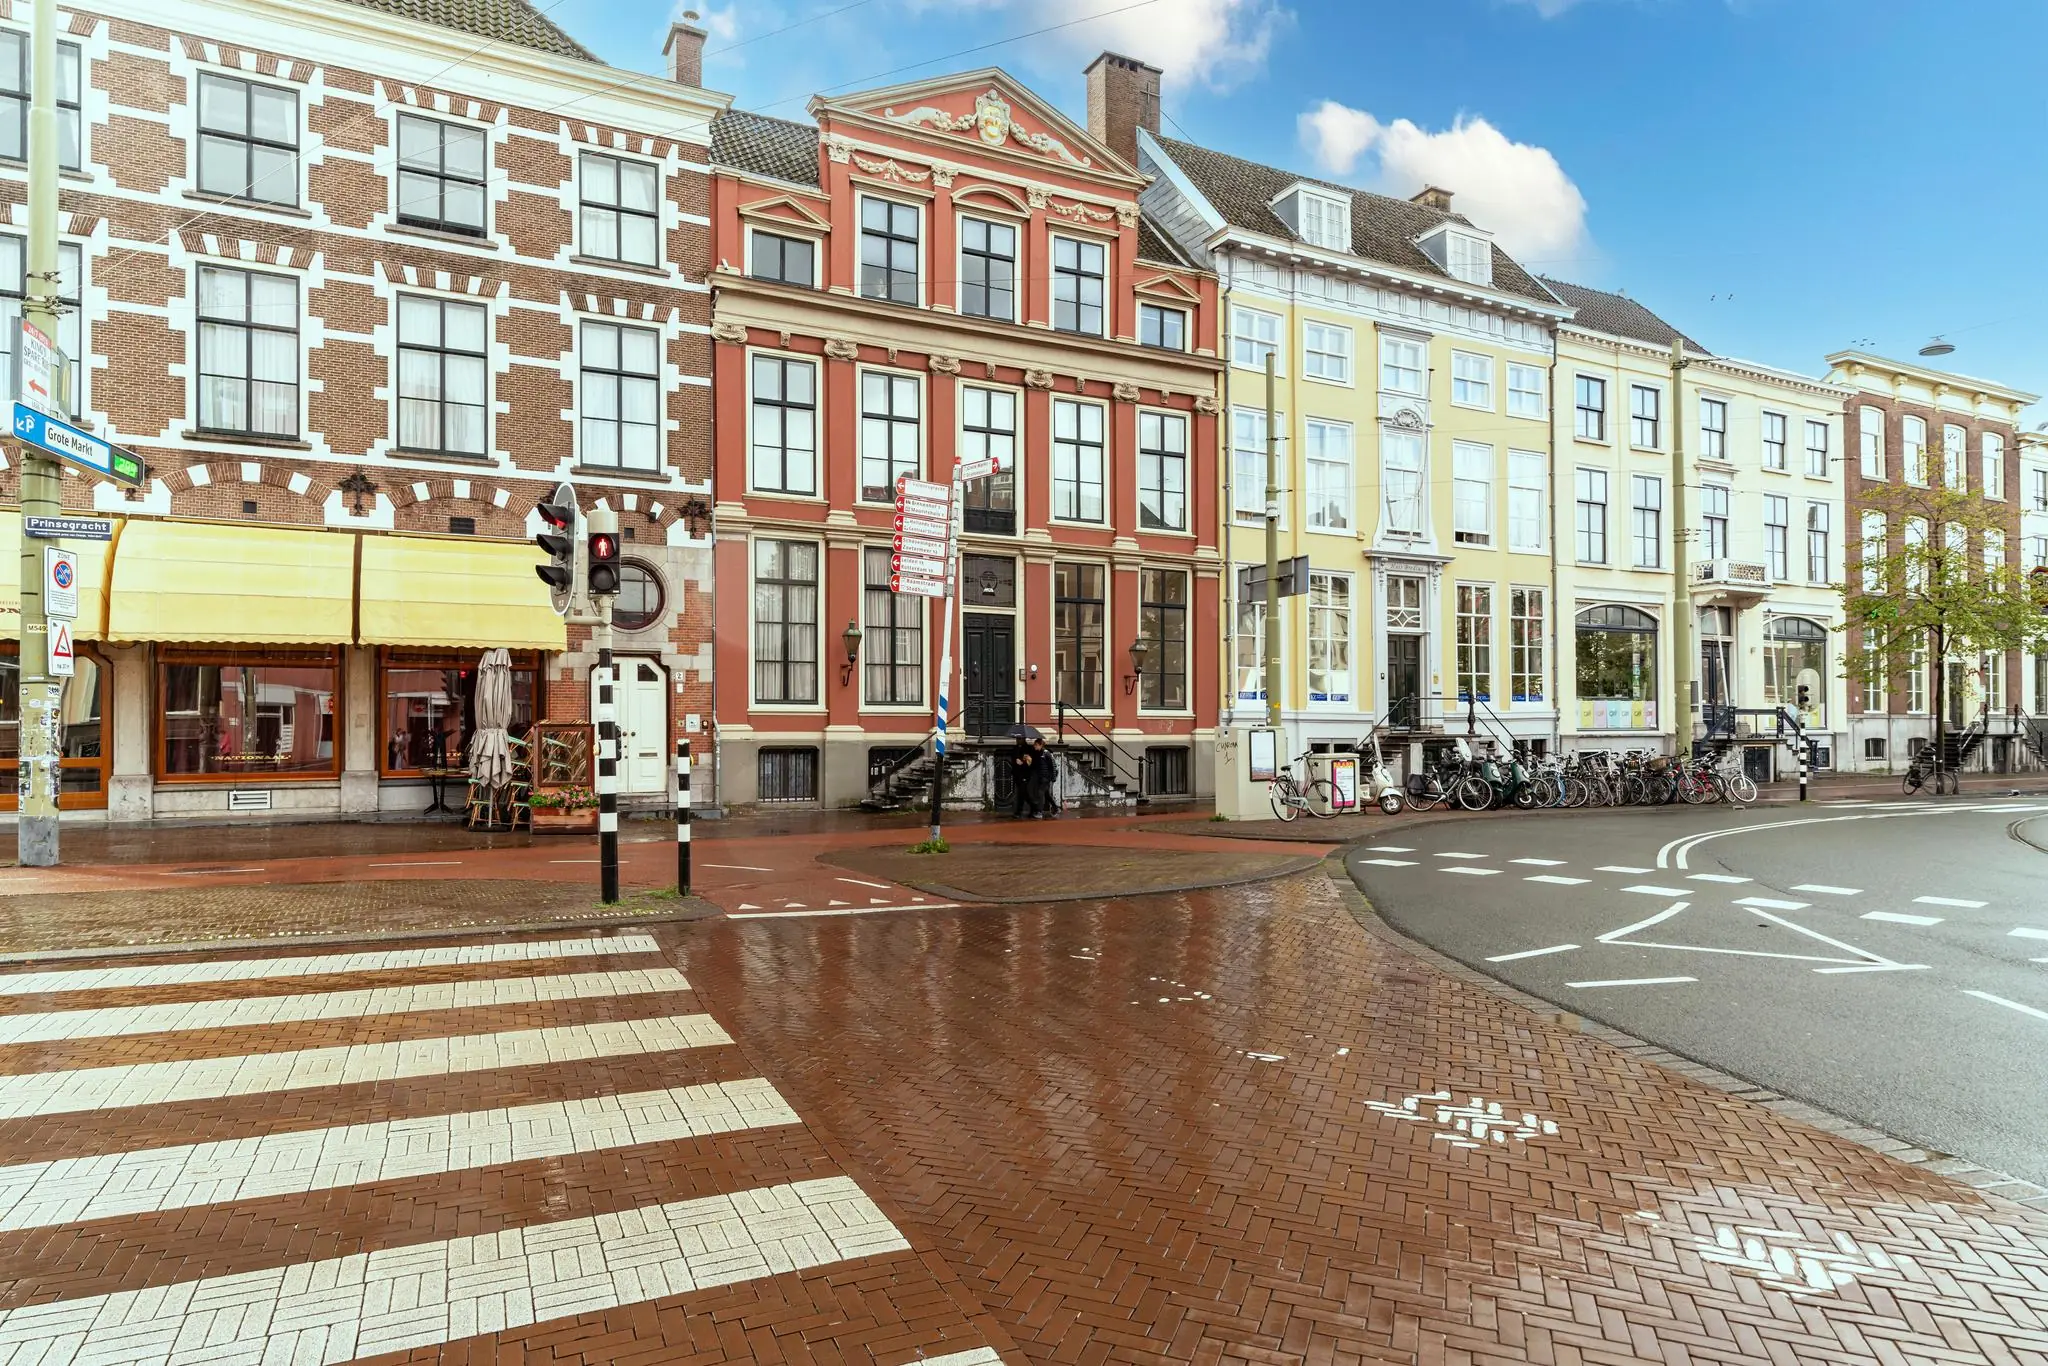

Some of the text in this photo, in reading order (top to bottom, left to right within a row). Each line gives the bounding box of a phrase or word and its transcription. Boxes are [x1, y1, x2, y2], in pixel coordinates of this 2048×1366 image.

[48, 427, 93, 457] Grote Markt
[30, 518, 108, 533] Prinsegracht
